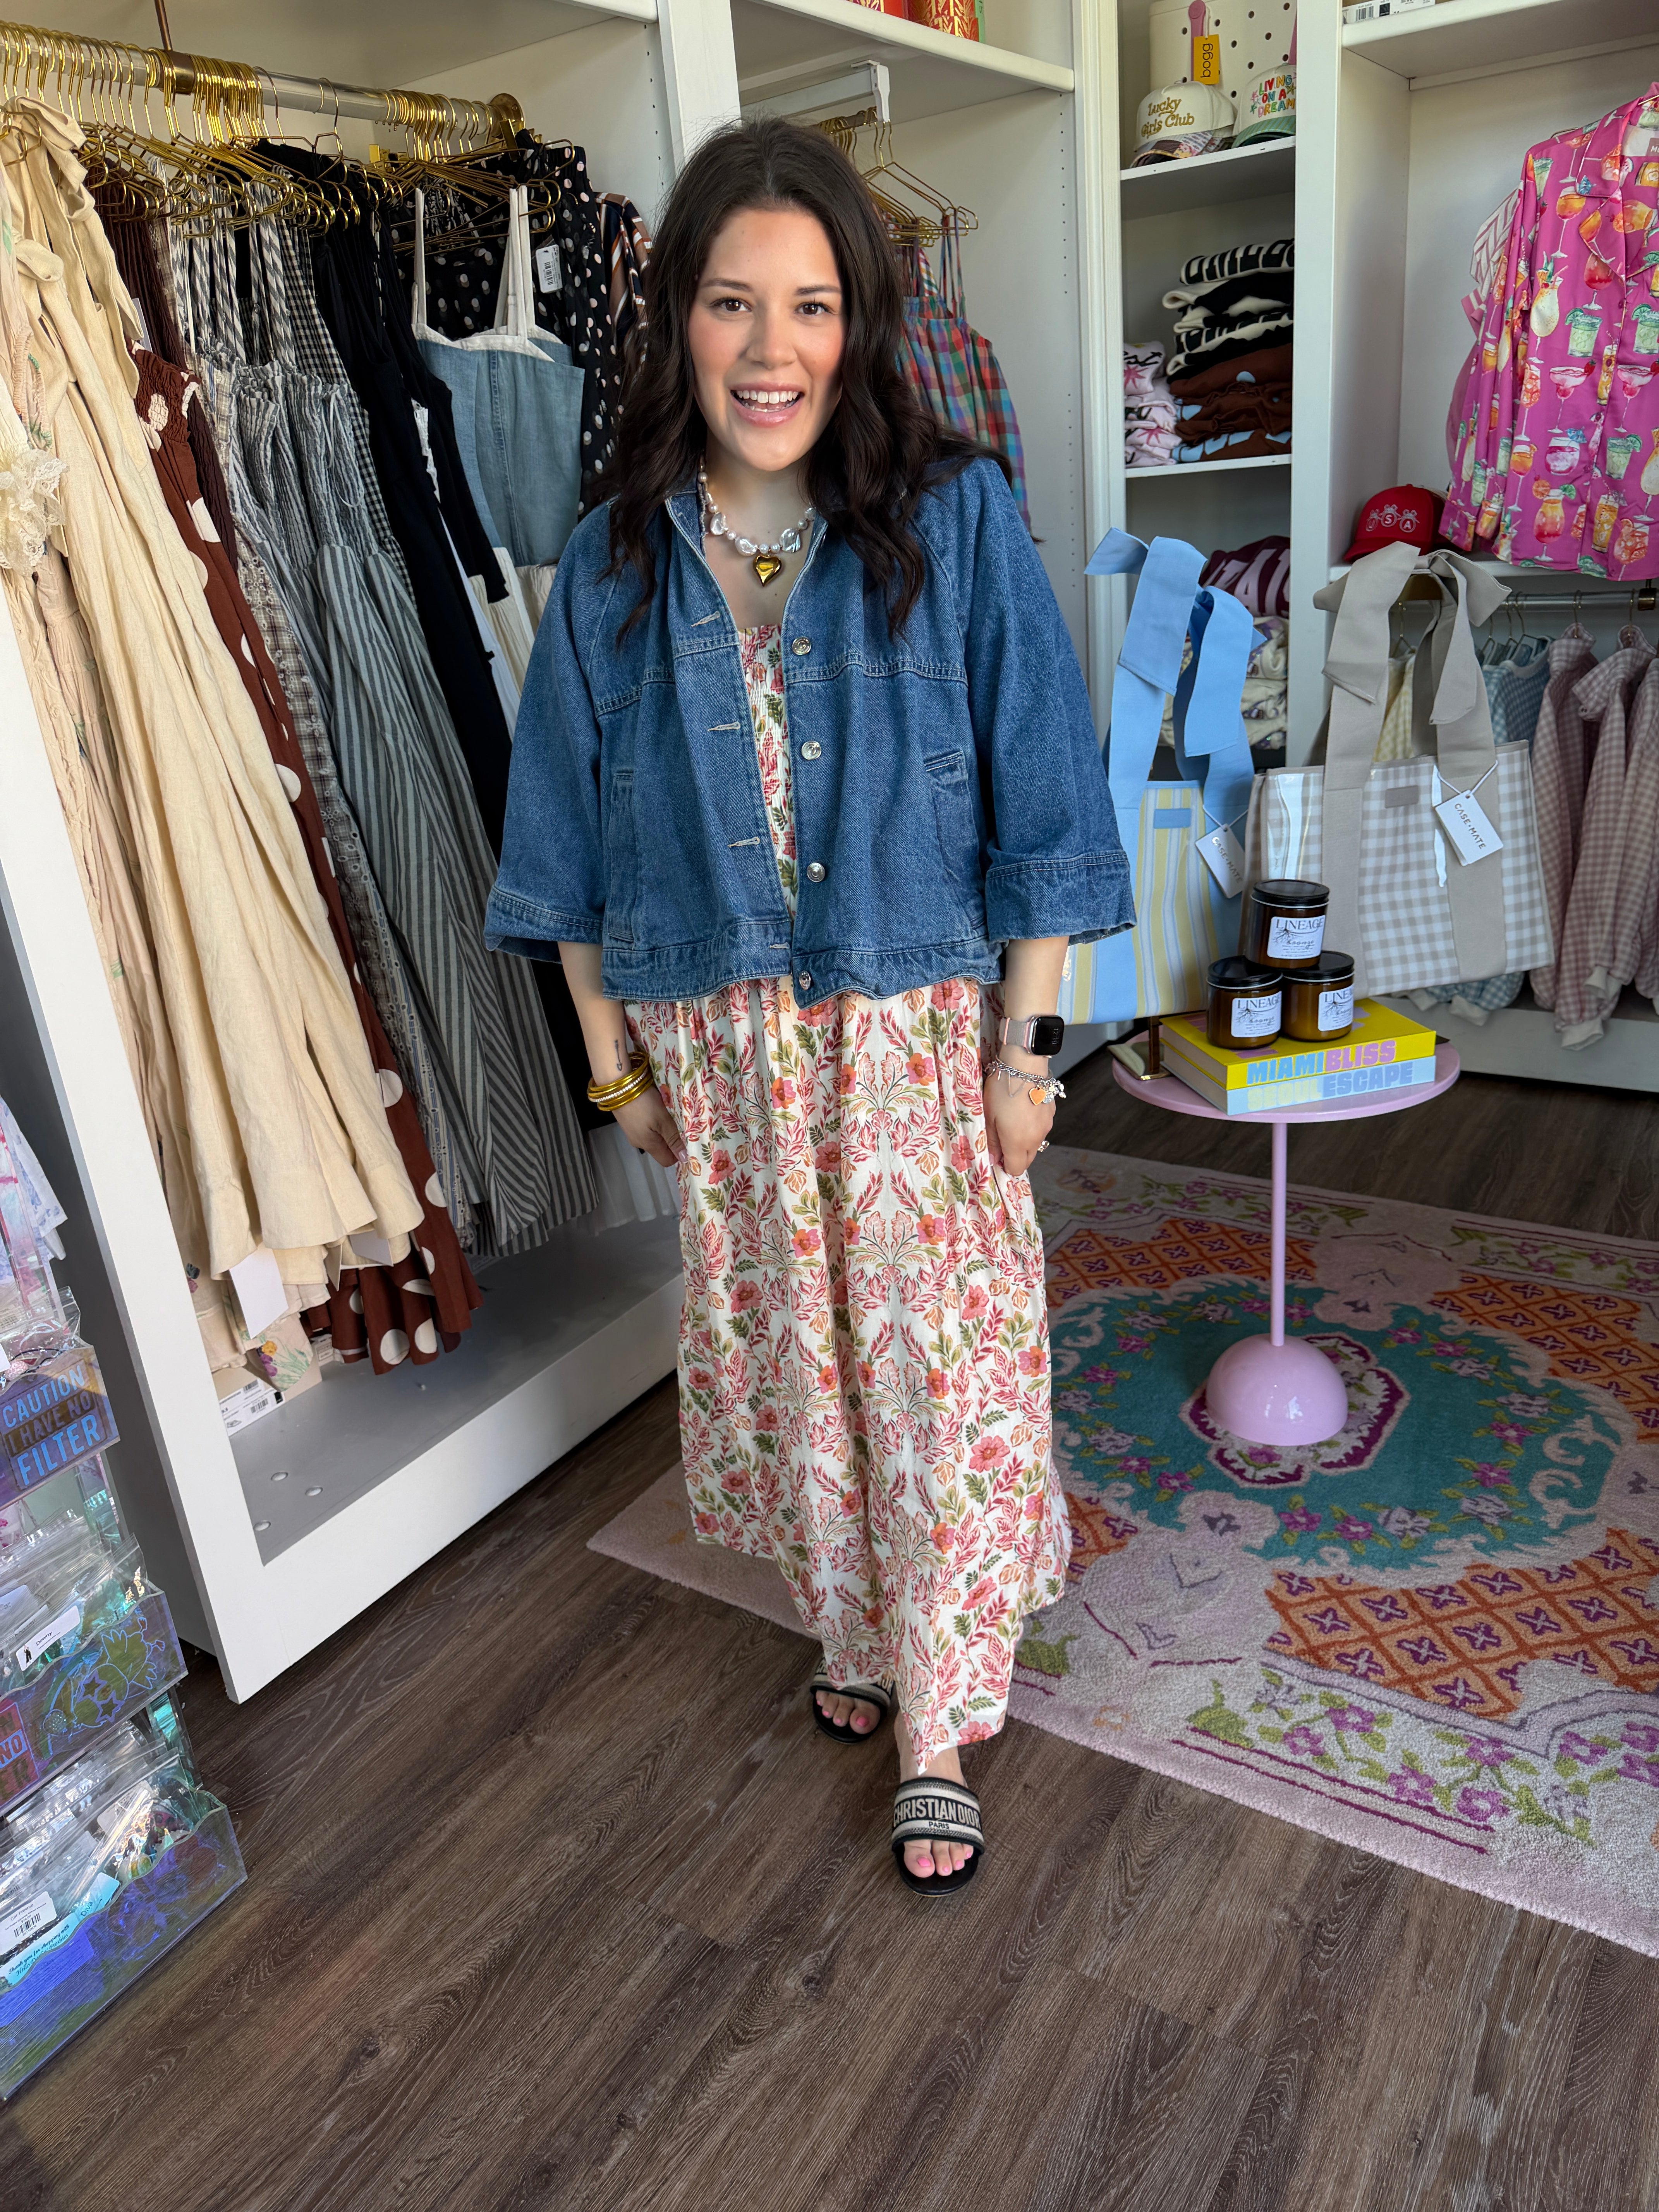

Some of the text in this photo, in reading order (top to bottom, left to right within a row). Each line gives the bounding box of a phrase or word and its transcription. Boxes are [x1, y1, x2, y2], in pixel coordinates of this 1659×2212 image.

[1200, 43, 1213, 78] bogg
[1259, 75, 1292, 96] LIVING
[1262, 88, 1286, 103] ON A
[1148, 97, 1182, 117] Lucky
[1258, 98, 1295, 117] DREAM
[1165, 113, 1195, 127] Club
[1276, 917, 1324, 930] LINEAGE
[1246, 1040, 1396, 1086] MIAMI BLISS
[1247, 1062, 1413, 1111] SEOUL ESCAPE
[3, 1365, 85, 1428] CAUTION
[8, 1391, 91, 1453] I HAVE NO
[17, 1415, 100, 1486] FILTER
[893, 1798, 981, 1832] CHRISTIAN DIOR
[929, 1821, 949, 1829] PARIS
[81, 1901, 93, 1917] Diva
[9, 1961, 23, 1974] Thank
[24, 1954, 33, 1964] you
[41, 1933, 60, 1950] shopping
[61, 1924, 70, 1934] with
[16, 1964, 30, 1976] Hello
